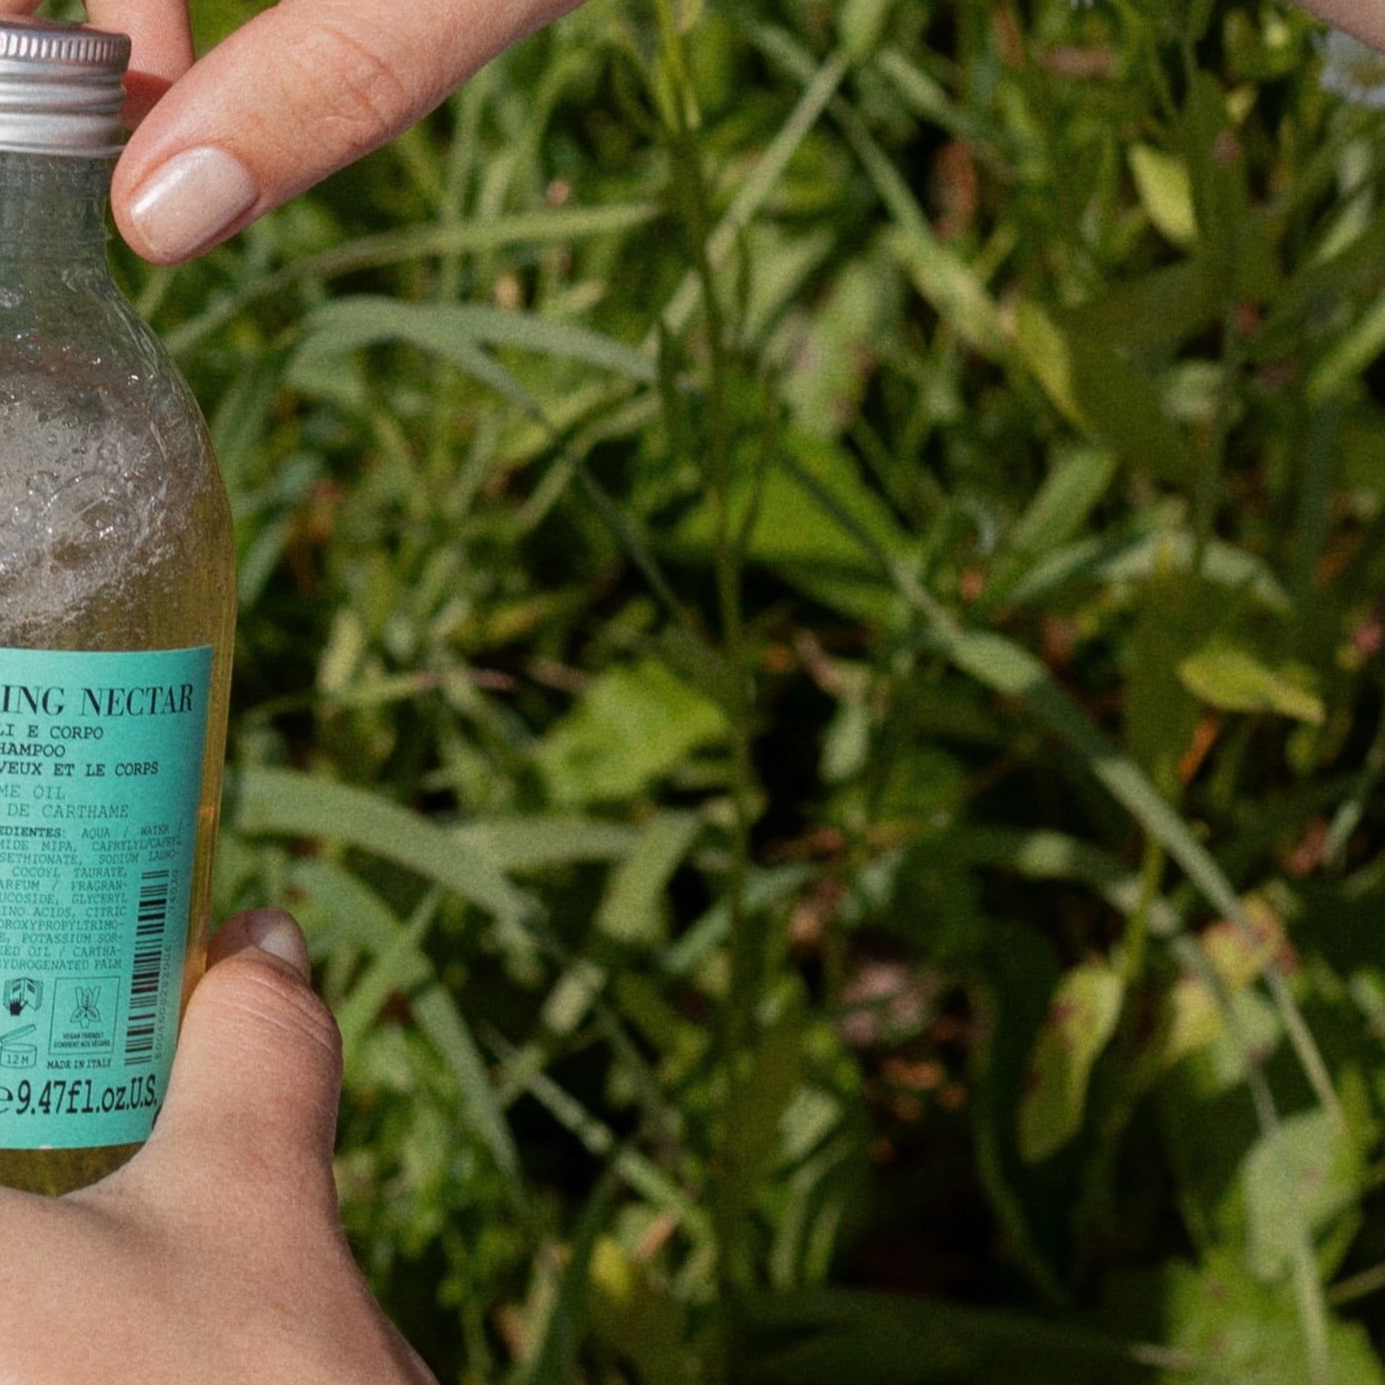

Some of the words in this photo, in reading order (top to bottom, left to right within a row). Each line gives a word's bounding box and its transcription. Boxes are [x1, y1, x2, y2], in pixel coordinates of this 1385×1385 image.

[81, 683, 193, 716] NECTAR
[27, 725, 39, 738] E
[50, 726, 104, 740] CORPO
[53, 763, 75, 777] ET
[86, 763, 105, 777] LE
[115, 761, 159, 776] CORPS
[33, 784, 65, 800] OIL
[7, 802, 30, 817] DE
[41, 804, 130, 818] CARTHAME
[81, 827, 111, 839] AQUA
[140, 824, 168, 836] WATER
[99, 853, 139, 865] SODIUM
[12, 865, 61, 878] COCOYL
[71, 893, 128, 904] GLYCERYL
[86, 906, 128, 917] CITRIC
[22, 932, 92, 944] POTASSIUM
[28, 946, 52, 958] OIL
[94, 959, 123, 970] PALM
[47, 1059, 72, 1070] MADE
[74, 1059, 85, 1070] IN
[87, 1056, 112, 1069] ITALY
